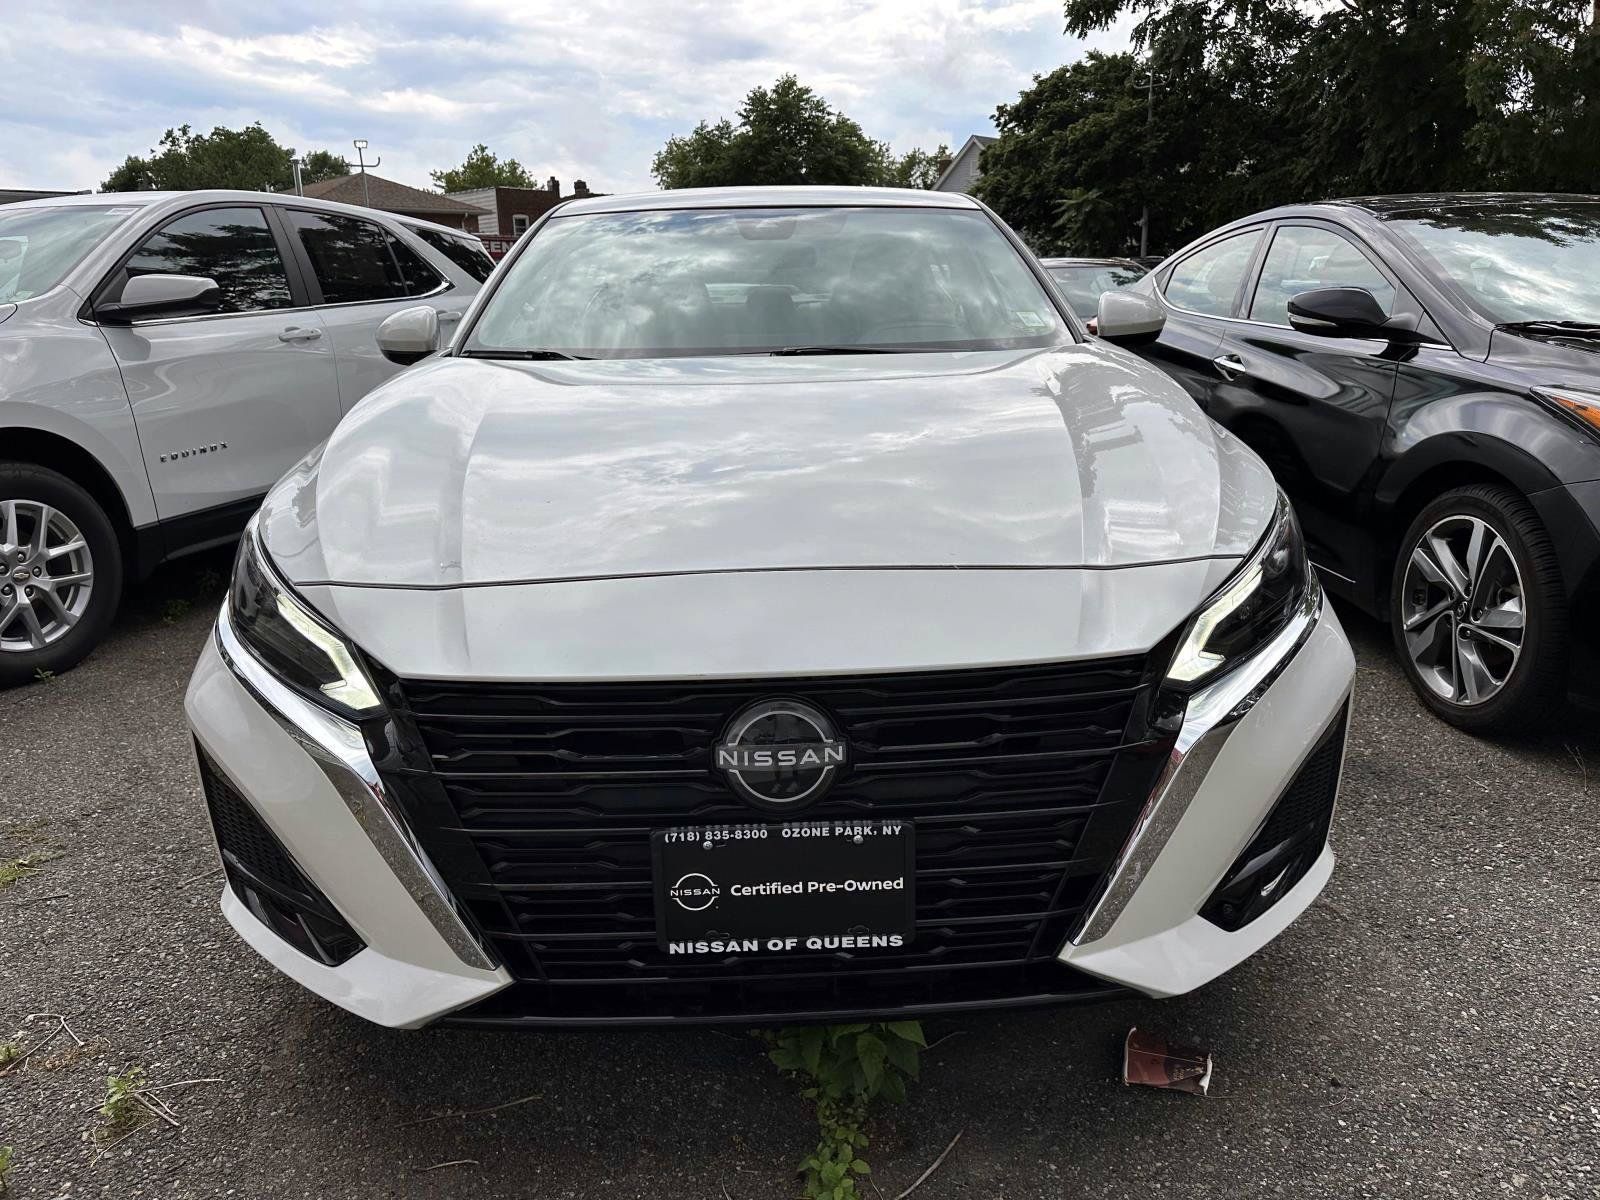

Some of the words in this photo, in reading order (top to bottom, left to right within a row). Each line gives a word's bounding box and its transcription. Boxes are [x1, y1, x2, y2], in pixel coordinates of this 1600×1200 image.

[160, 441, 228, 464] EQUINOX
[719, 745, 844, 767] NISSAN
[664, 831, 700, 844] (718)
[704, 829, 768, 841] 835-8300
[781, 827, 830, 838] OZONE
[834, 826, 878, 836] PARK,
[882, 825, 902, 836] NY
[670, 887, 720, 897] NISSAN
[730, 881, 803, 896] Certified
[807, 877, 905, 893] Pre-Owned
[669, 940, 759, 955] NISSAN
[766, 938, 798, 951] OF
[805, 935, 904, 950] QUEENS
